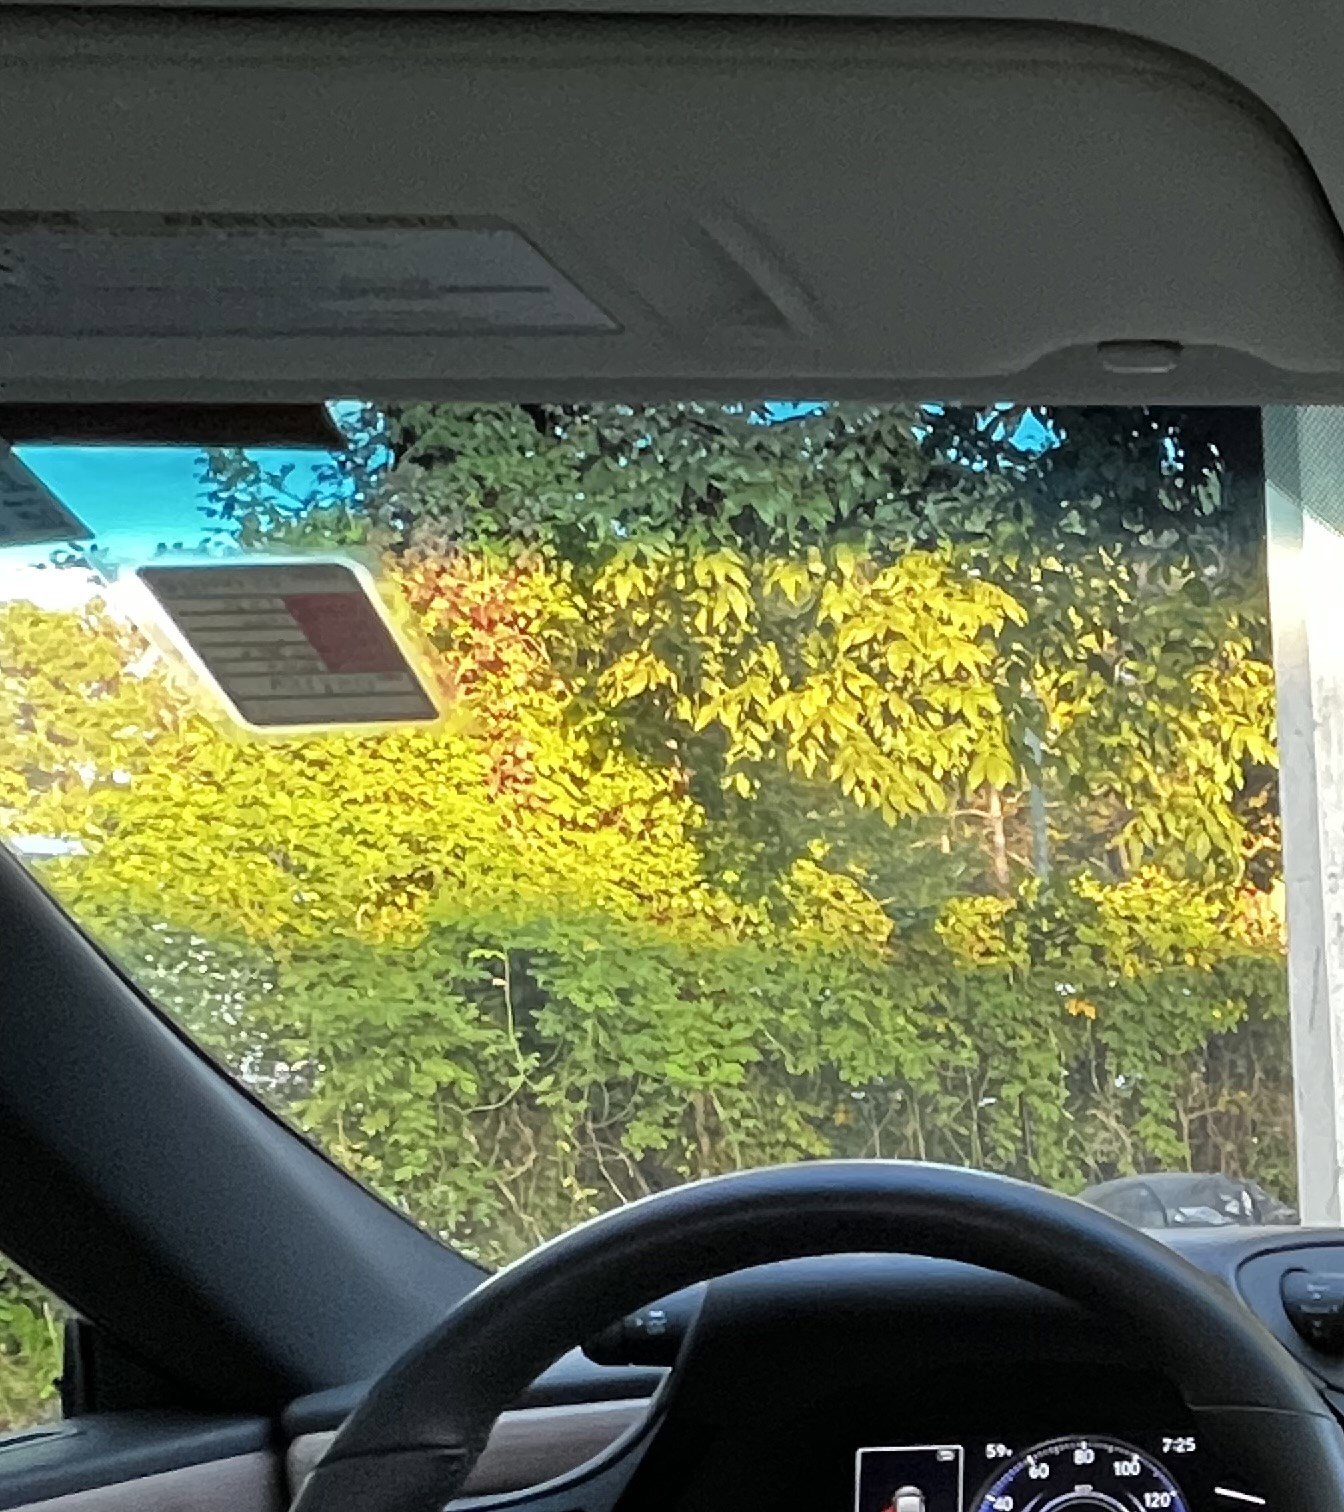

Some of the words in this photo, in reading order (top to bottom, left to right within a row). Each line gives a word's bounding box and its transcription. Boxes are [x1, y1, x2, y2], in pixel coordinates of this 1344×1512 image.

[1162, 1437, 1196, 1453] 7:25
[1073, 1449, 1095, 1464] 80
[1028, 1463, 1049, 1479] 60
[1113, 1461, 1141, 1476] 100
[993, 1496, 1014, 1511] 40
[1143, 1492, 1171, 1508] 120
